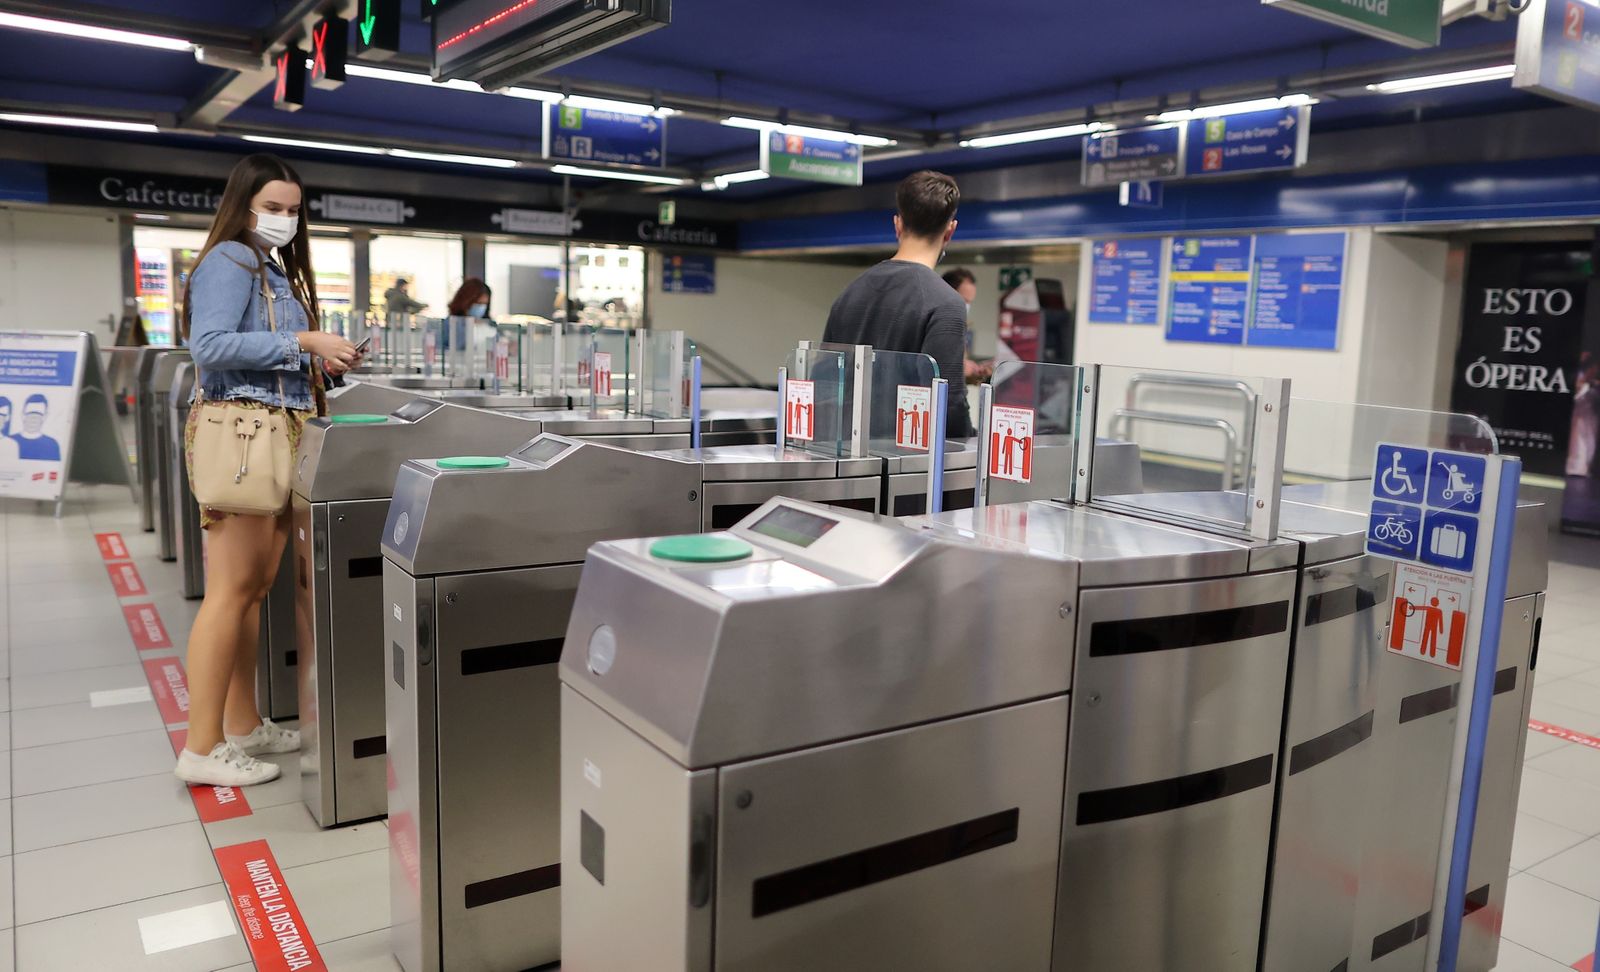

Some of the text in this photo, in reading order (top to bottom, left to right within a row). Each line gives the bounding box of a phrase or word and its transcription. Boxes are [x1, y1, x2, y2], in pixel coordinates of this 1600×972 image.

[1567, 7, 1579, 36] 2
[565, 107, 577, 128] 5
[1211, 121, 1221, 141] 5
[1206, 150, 1218, 168] 2
[1482, 288, 1573, 316] ESTO
[1502, 326, 1542, 353] ES
[1465, 356, 1570, 393] ÓPERA
[245, 858, 312, 972] MANTÉN LA DISTANCIA
